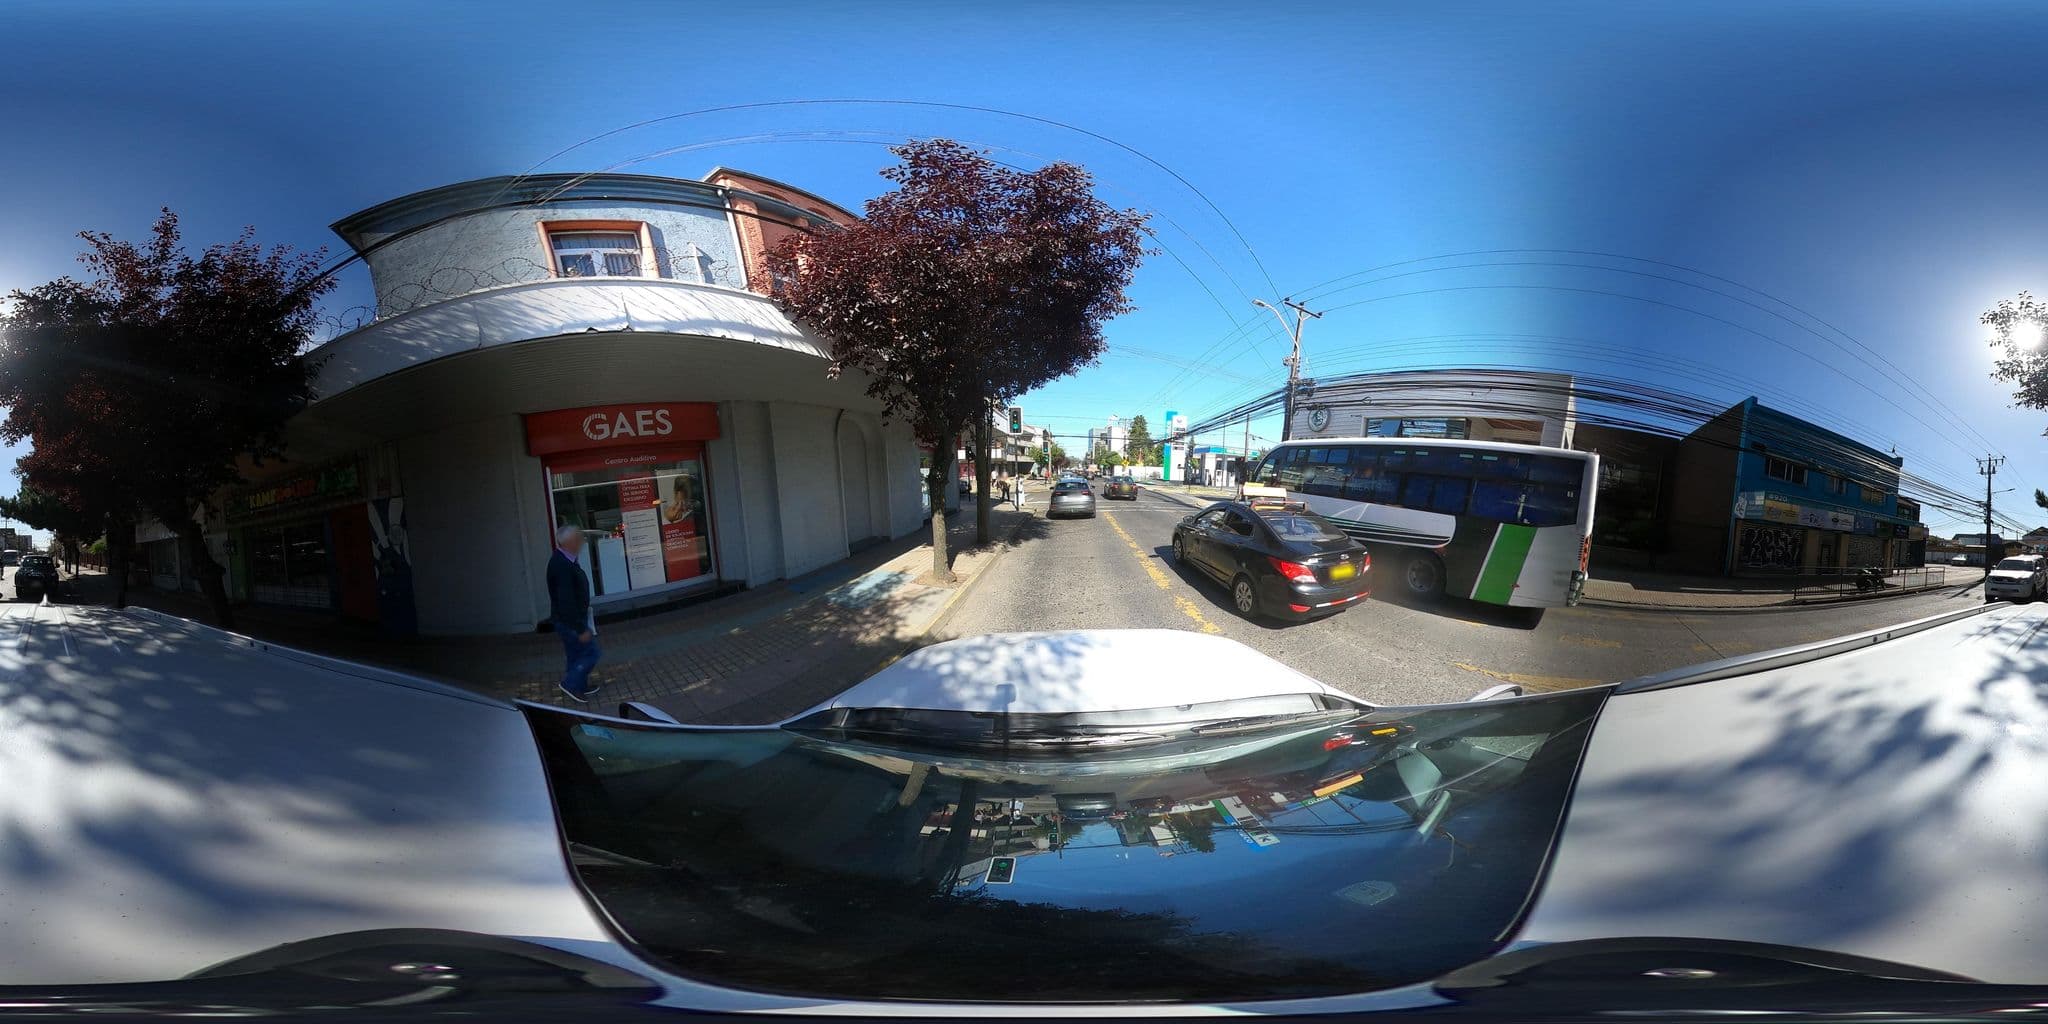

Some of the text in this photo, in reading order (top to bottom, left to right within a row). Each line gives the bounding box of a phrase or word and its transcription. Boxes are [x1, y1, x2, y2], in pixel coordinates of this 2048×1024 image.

[582, 408, 673, 440] GAES
[604, 455, 657, 465] Centro Auditivo
